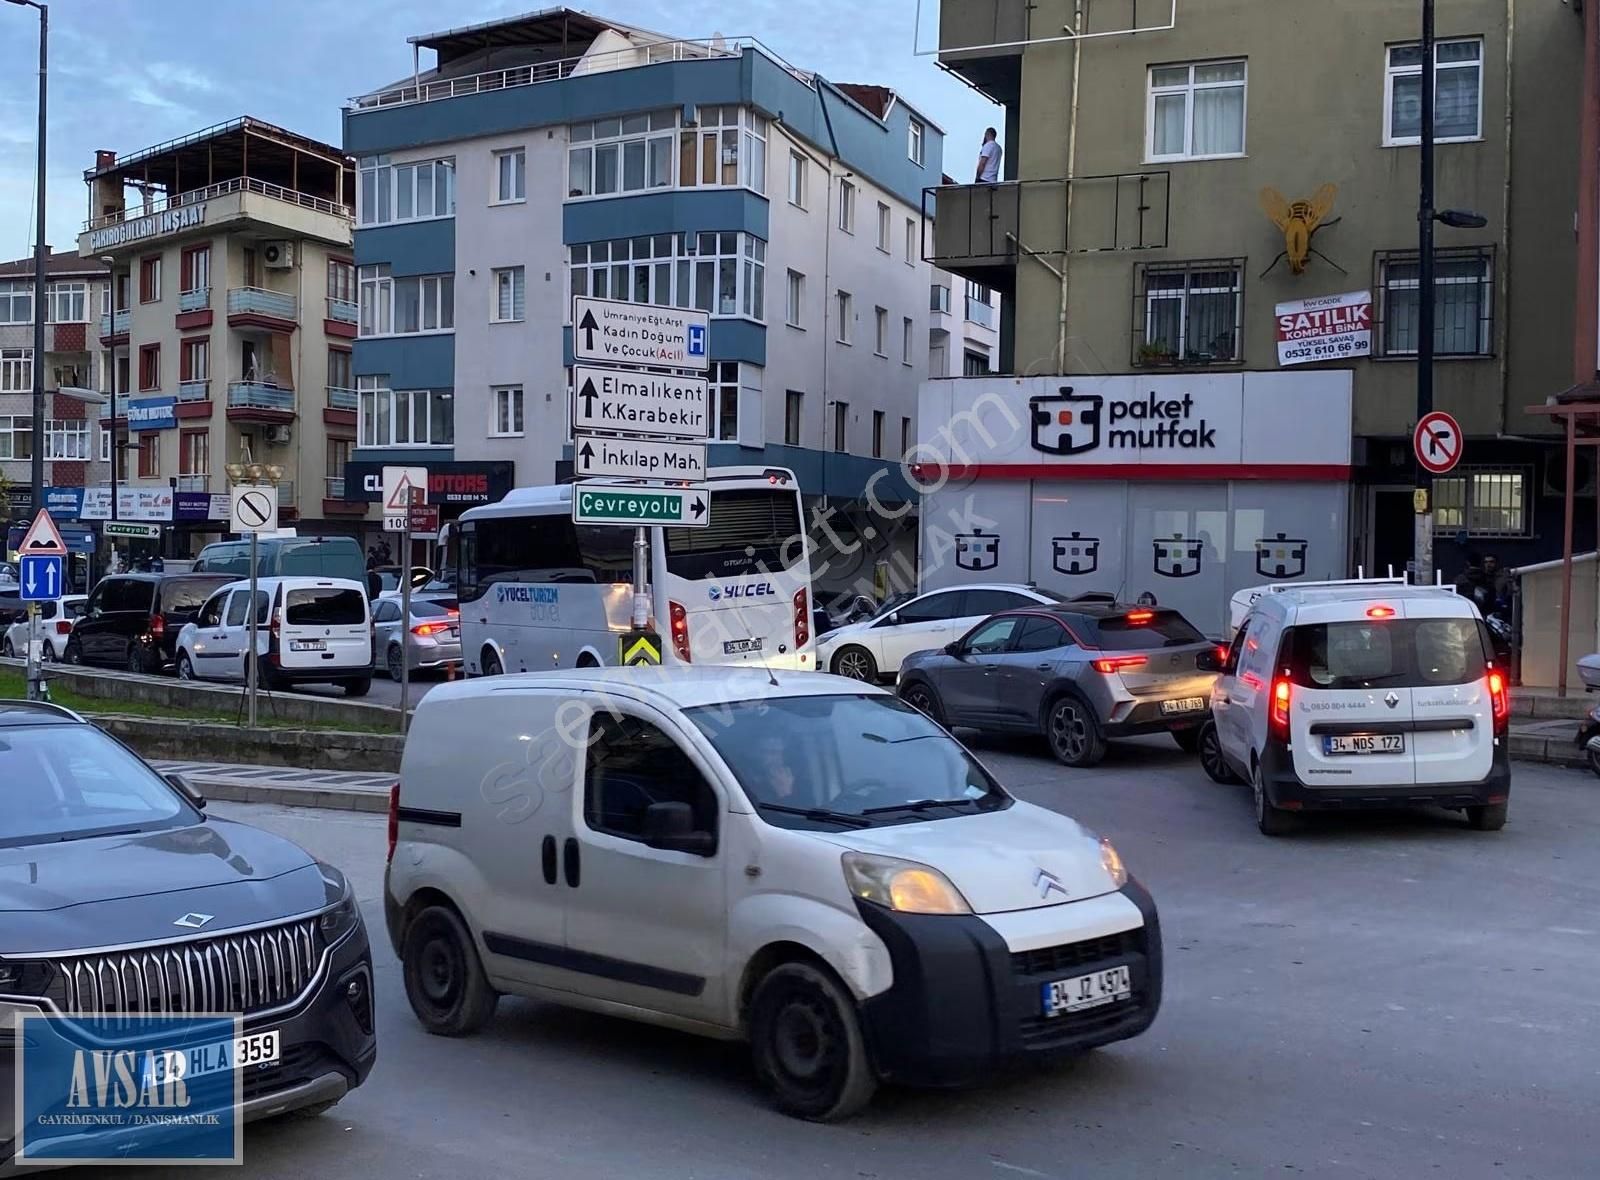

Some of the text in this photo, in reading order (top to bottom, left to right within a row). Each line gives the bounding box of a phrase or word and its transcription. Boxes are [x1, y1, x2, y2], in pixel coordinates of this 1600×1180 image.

[1280, 305, 1369, 331] SATILIK
[603, 325, 684, 344] Kadın Doğum
[691, 329, 704, 353] H
[1286, 326, 1333, 340] KOMPLE
[604, 343, 619, 353] Ve
[1285, 348, 1312, 359] 0532
[1315, 345, 1335, 356] 610
[1338, 342, 1351, 353] 66
[1354, 340, 1368, 350] 99
[603, 377, 702, 401] Elmalıkent
[602, 402, 702, 425] K.Karabekir
[1109, 391, 1194, 425] paket
[1108, 419, 1216, 448] mutfak
[603, 444, 701, 471] İnkılap Mah.
[582, 494, 680, 517] Çevreyolu
[1332, 736, 1401, 750] 34 NDS 172
[1052, 983, 1069, 1007] 34
[1099, 968, 1129, 995] 4974
[191, 1044, 228, 1074] HLA
[237, 1034, 274, 1063] 359
